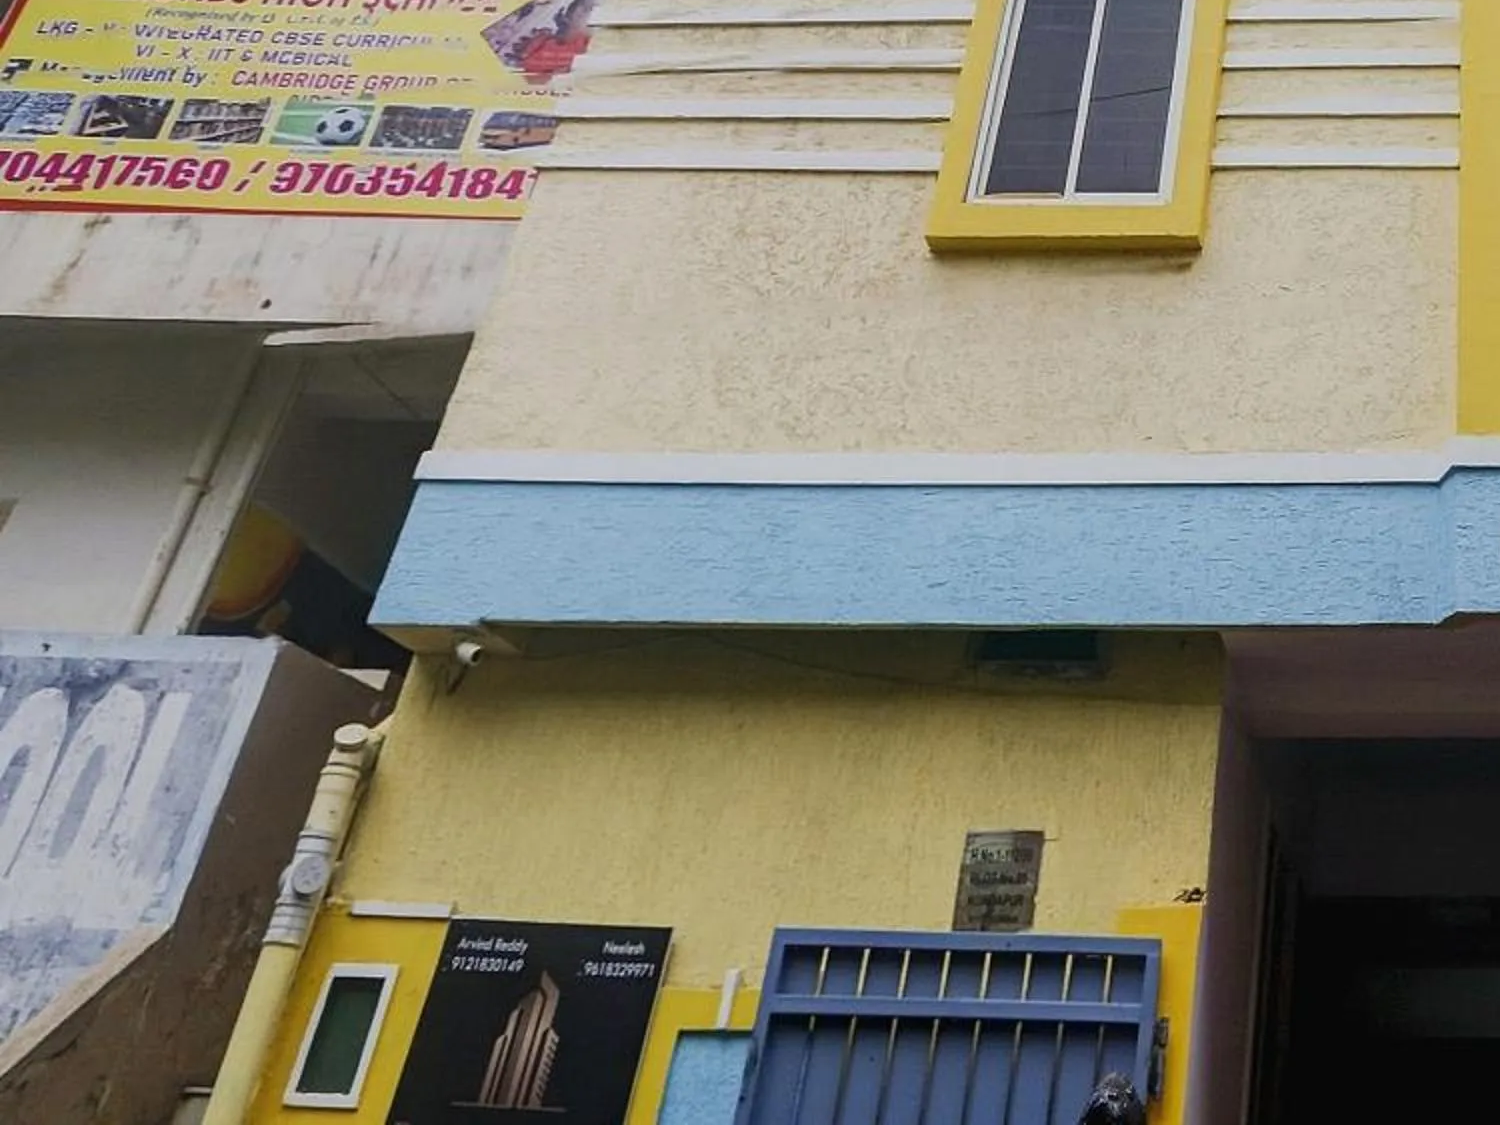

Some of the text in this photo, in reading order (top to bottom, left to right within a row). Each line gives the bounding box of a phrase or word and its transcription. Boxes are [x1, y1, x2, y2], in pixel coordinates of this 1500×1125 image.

[37, 20, 79, 36] LKG
[271, 31, 326, 48] CBSE
[208, 48, 235, 62] IIT
[231, 70, 357, 91] CAMBRIDGE
